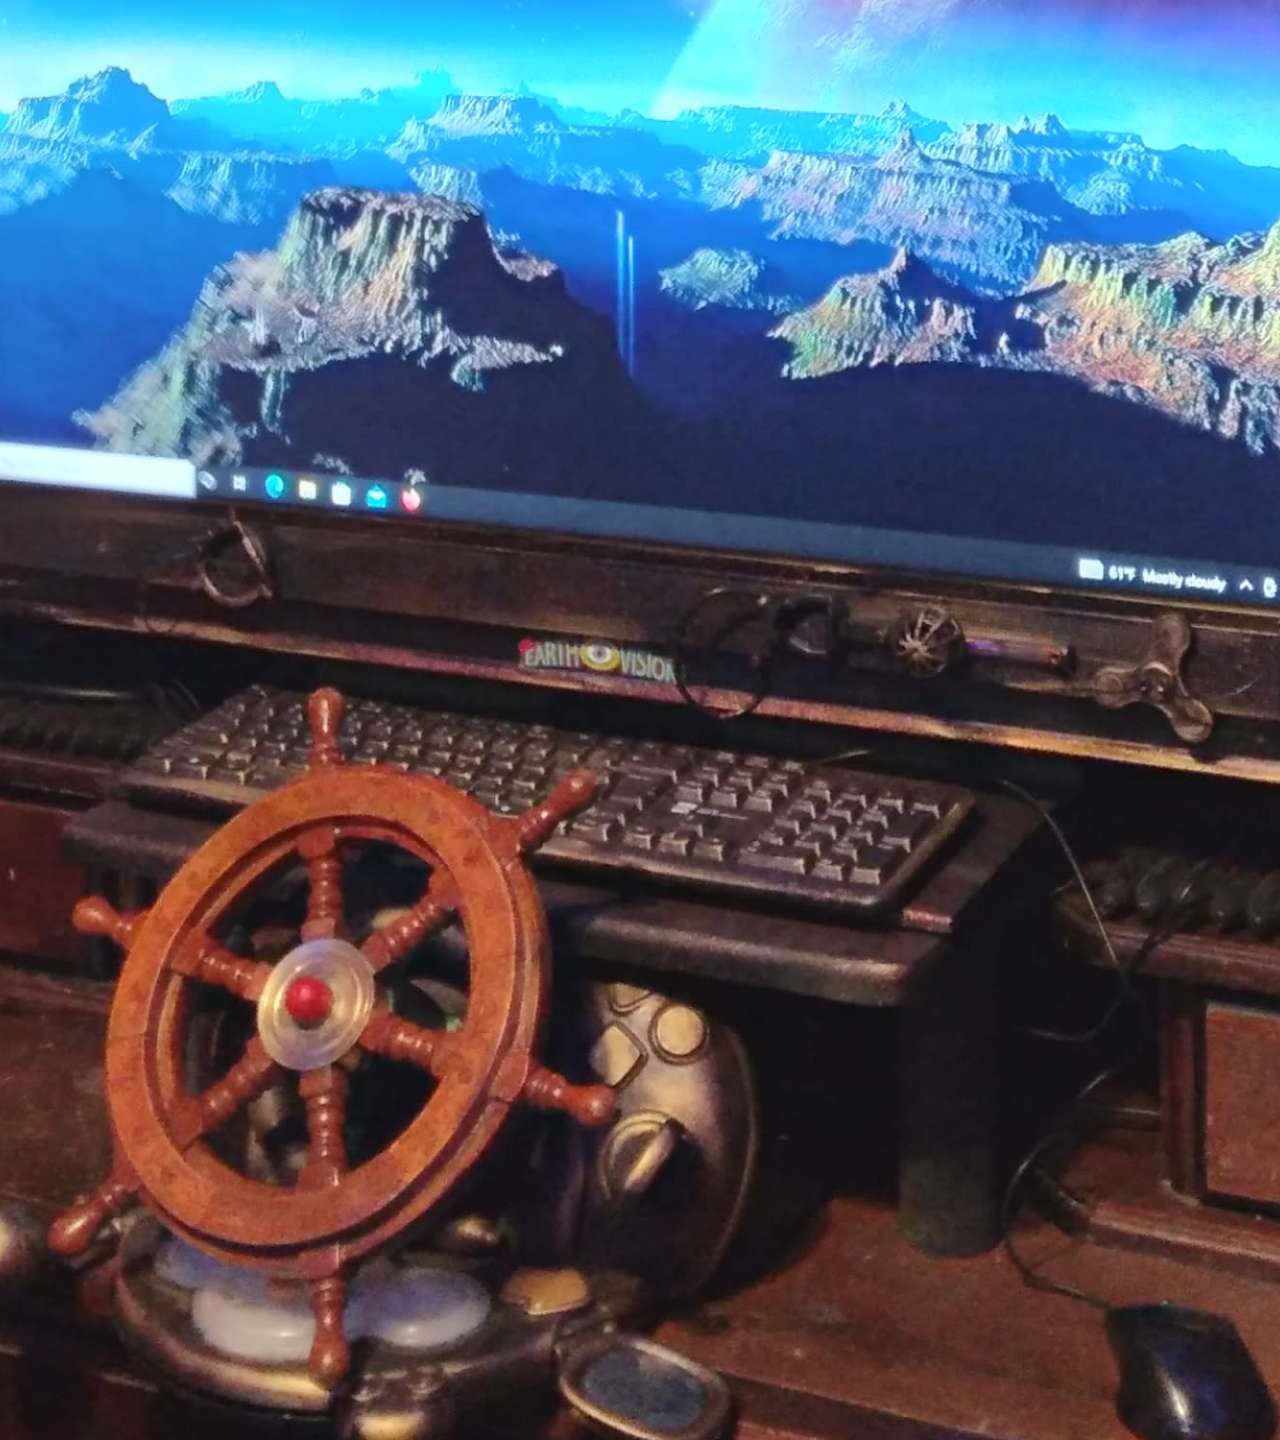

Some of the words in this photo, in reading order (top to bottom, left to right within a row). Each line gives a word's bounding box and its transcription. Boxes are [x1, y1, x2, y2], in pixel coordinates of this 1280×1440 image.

[1142, 568, 1183, 589] Mostly
[1184, 573, 1227, 594] cloudy
[620, 649, 678, 684] VISION
